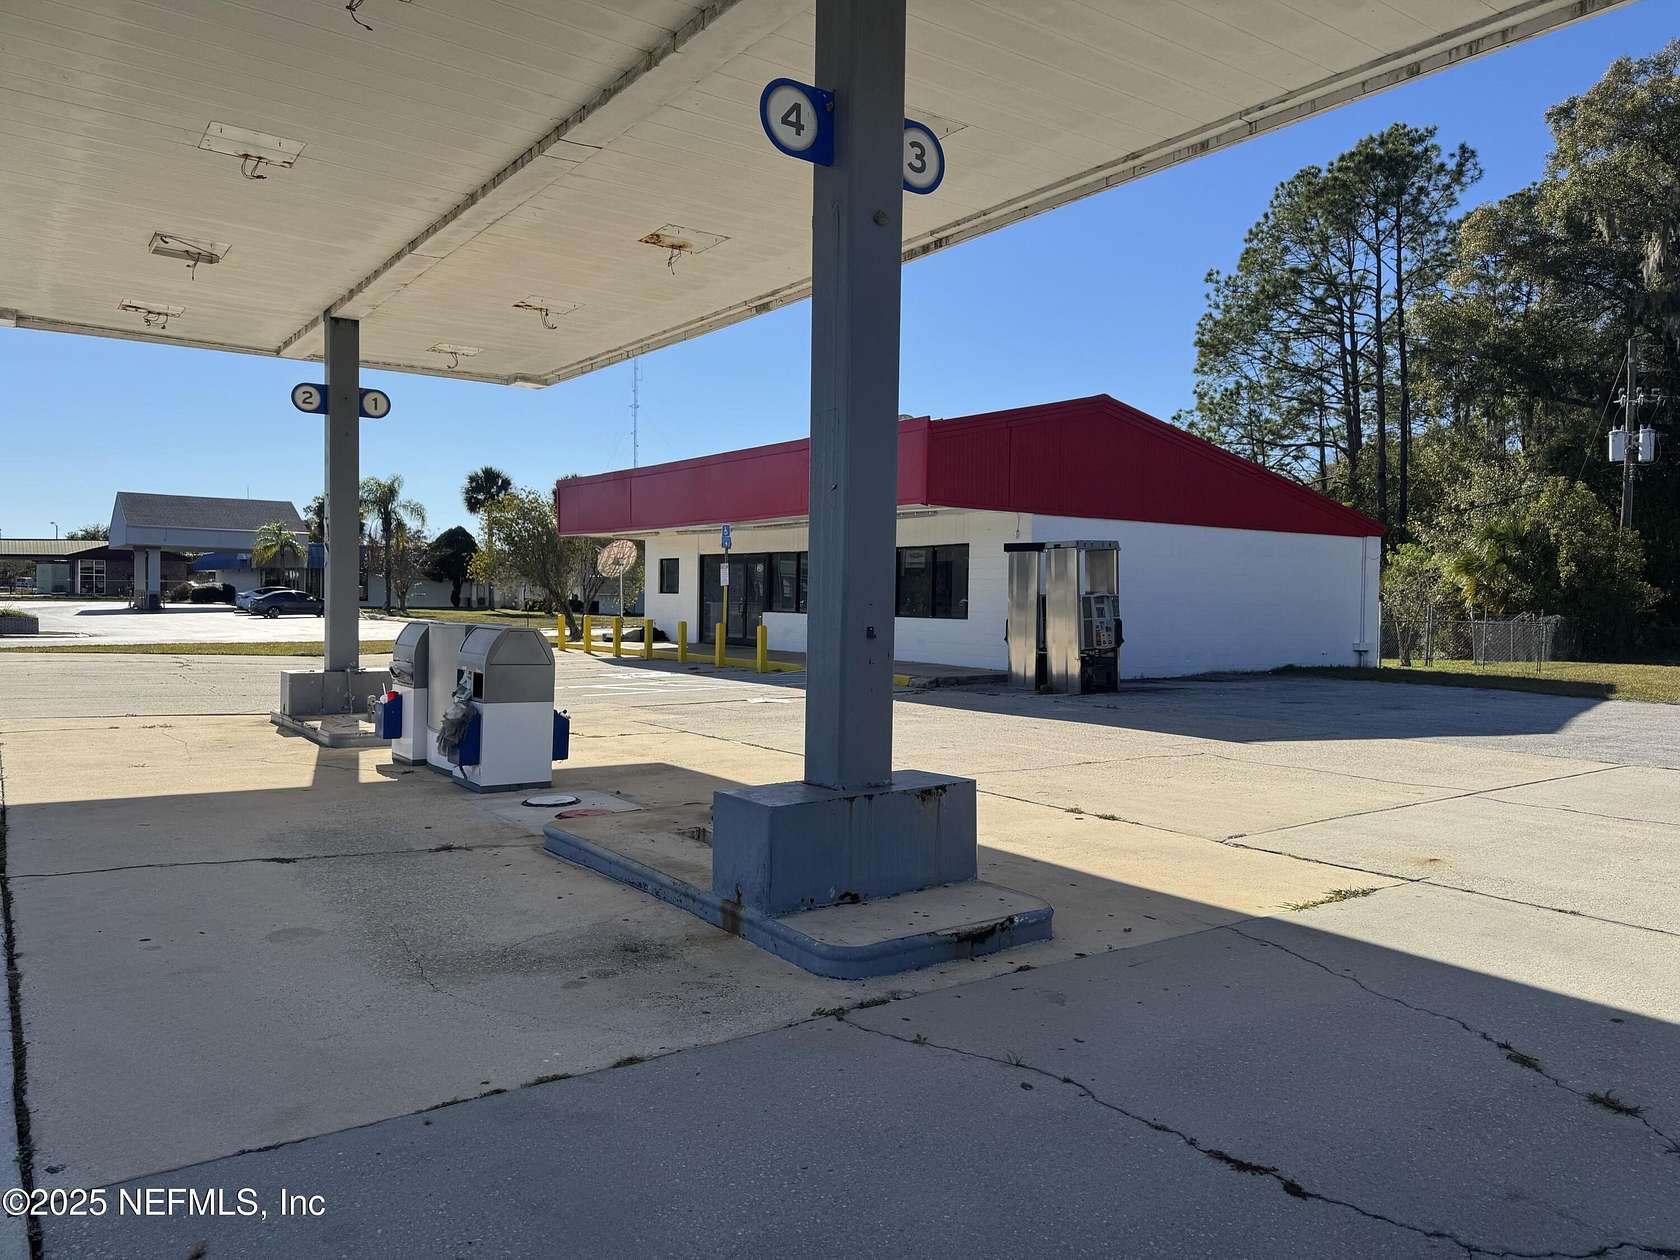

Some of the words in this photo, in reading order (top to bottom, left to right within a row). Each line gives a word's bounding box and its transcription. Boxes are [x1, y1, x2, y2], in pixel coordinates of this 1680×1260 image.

[780, 102, 805, 136] 4
[907, 141, 926, 174] 3
[302, 391, 313, 404] 2
[371, 397, 378, 411] 1
